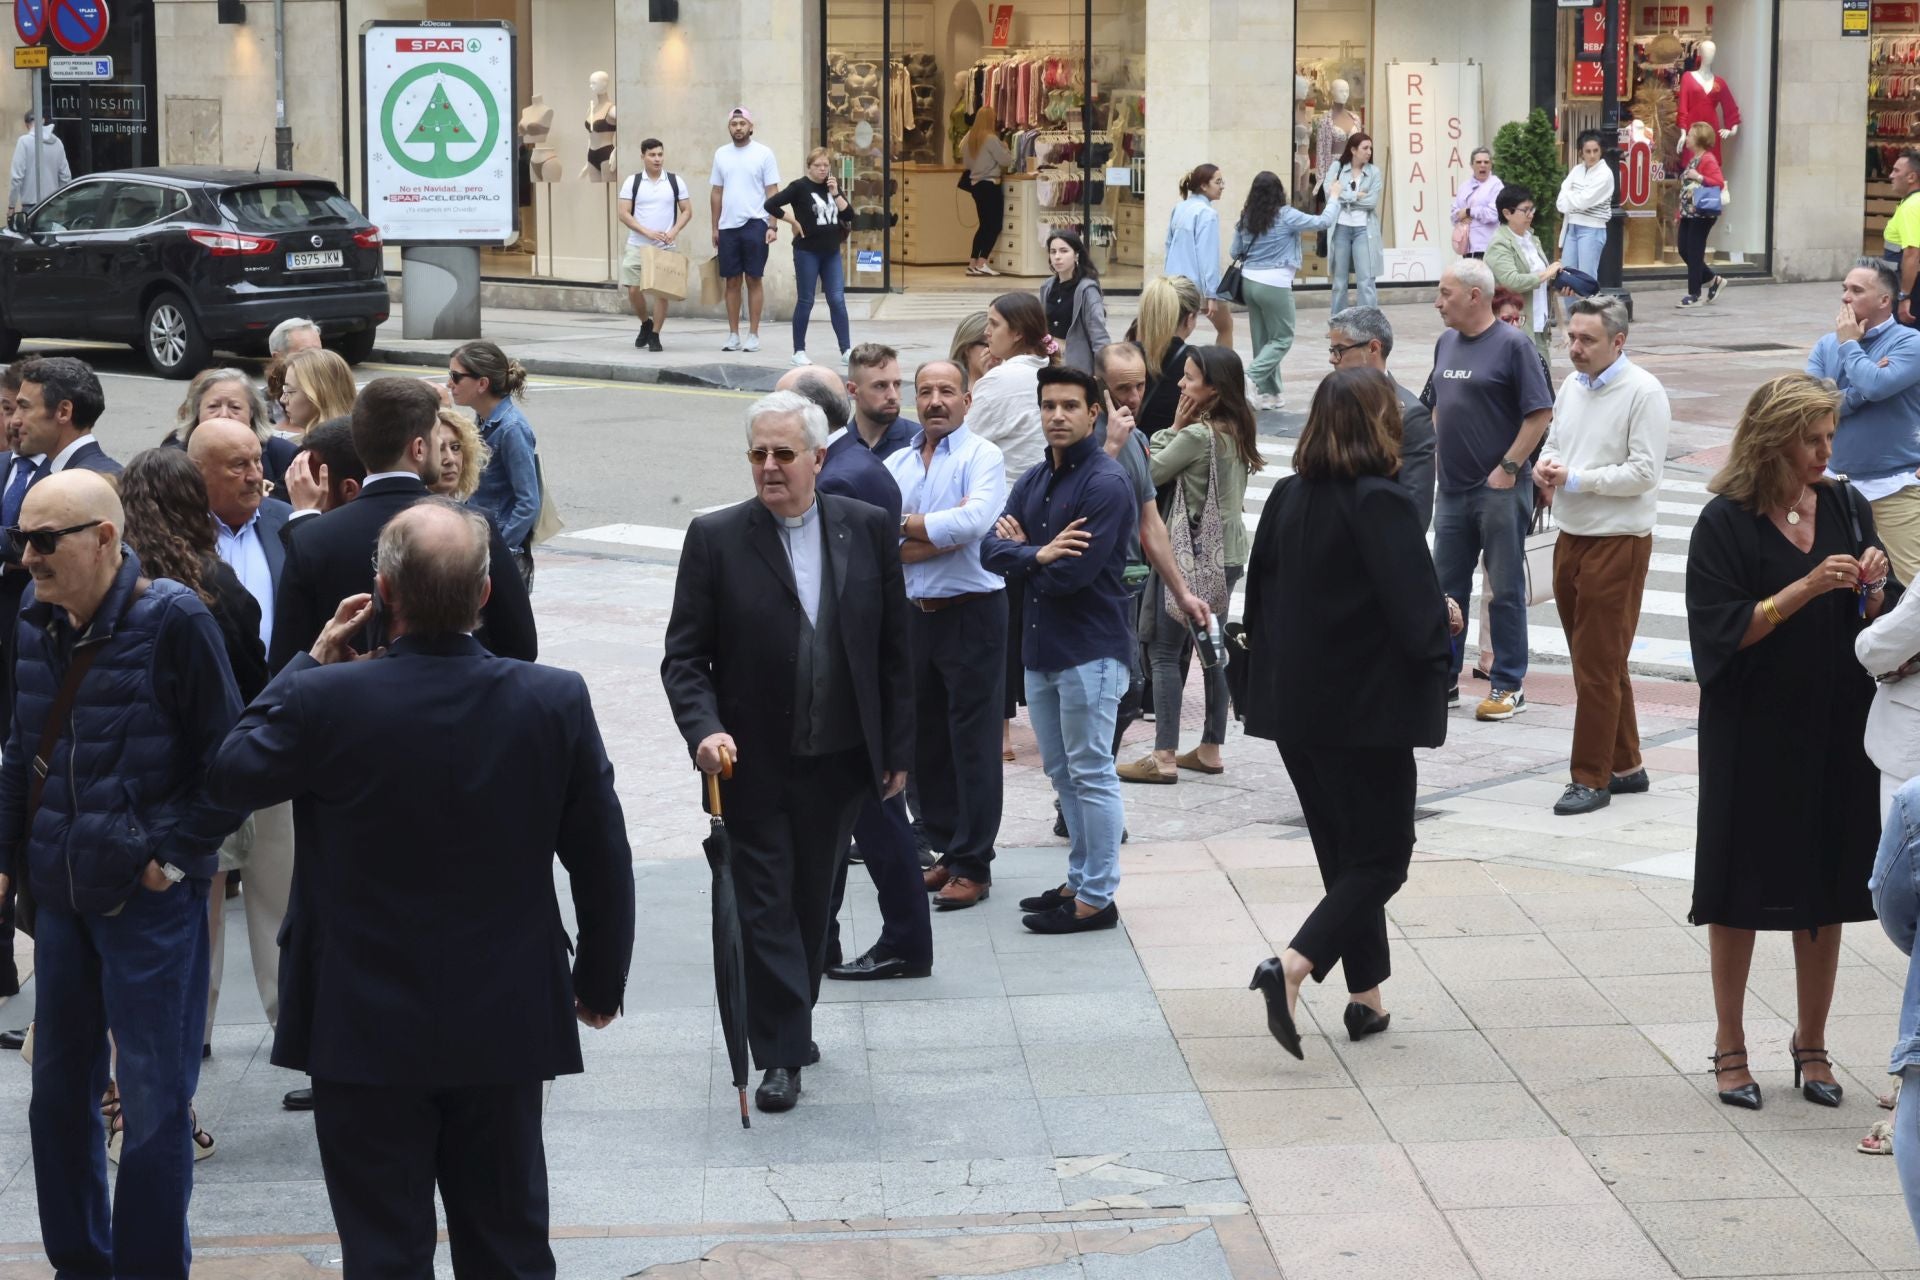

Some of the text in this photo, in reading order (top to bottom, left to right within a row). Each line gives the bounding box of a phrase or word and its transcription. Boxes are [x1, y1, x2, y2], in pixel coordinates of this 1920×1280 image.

[411, 40, 463, 51] SPAR
[91, 123, 147, 136] talian lingerie
[294, 253, 320, 265] 6975
[1443, 369, 1472, 379] GURU
